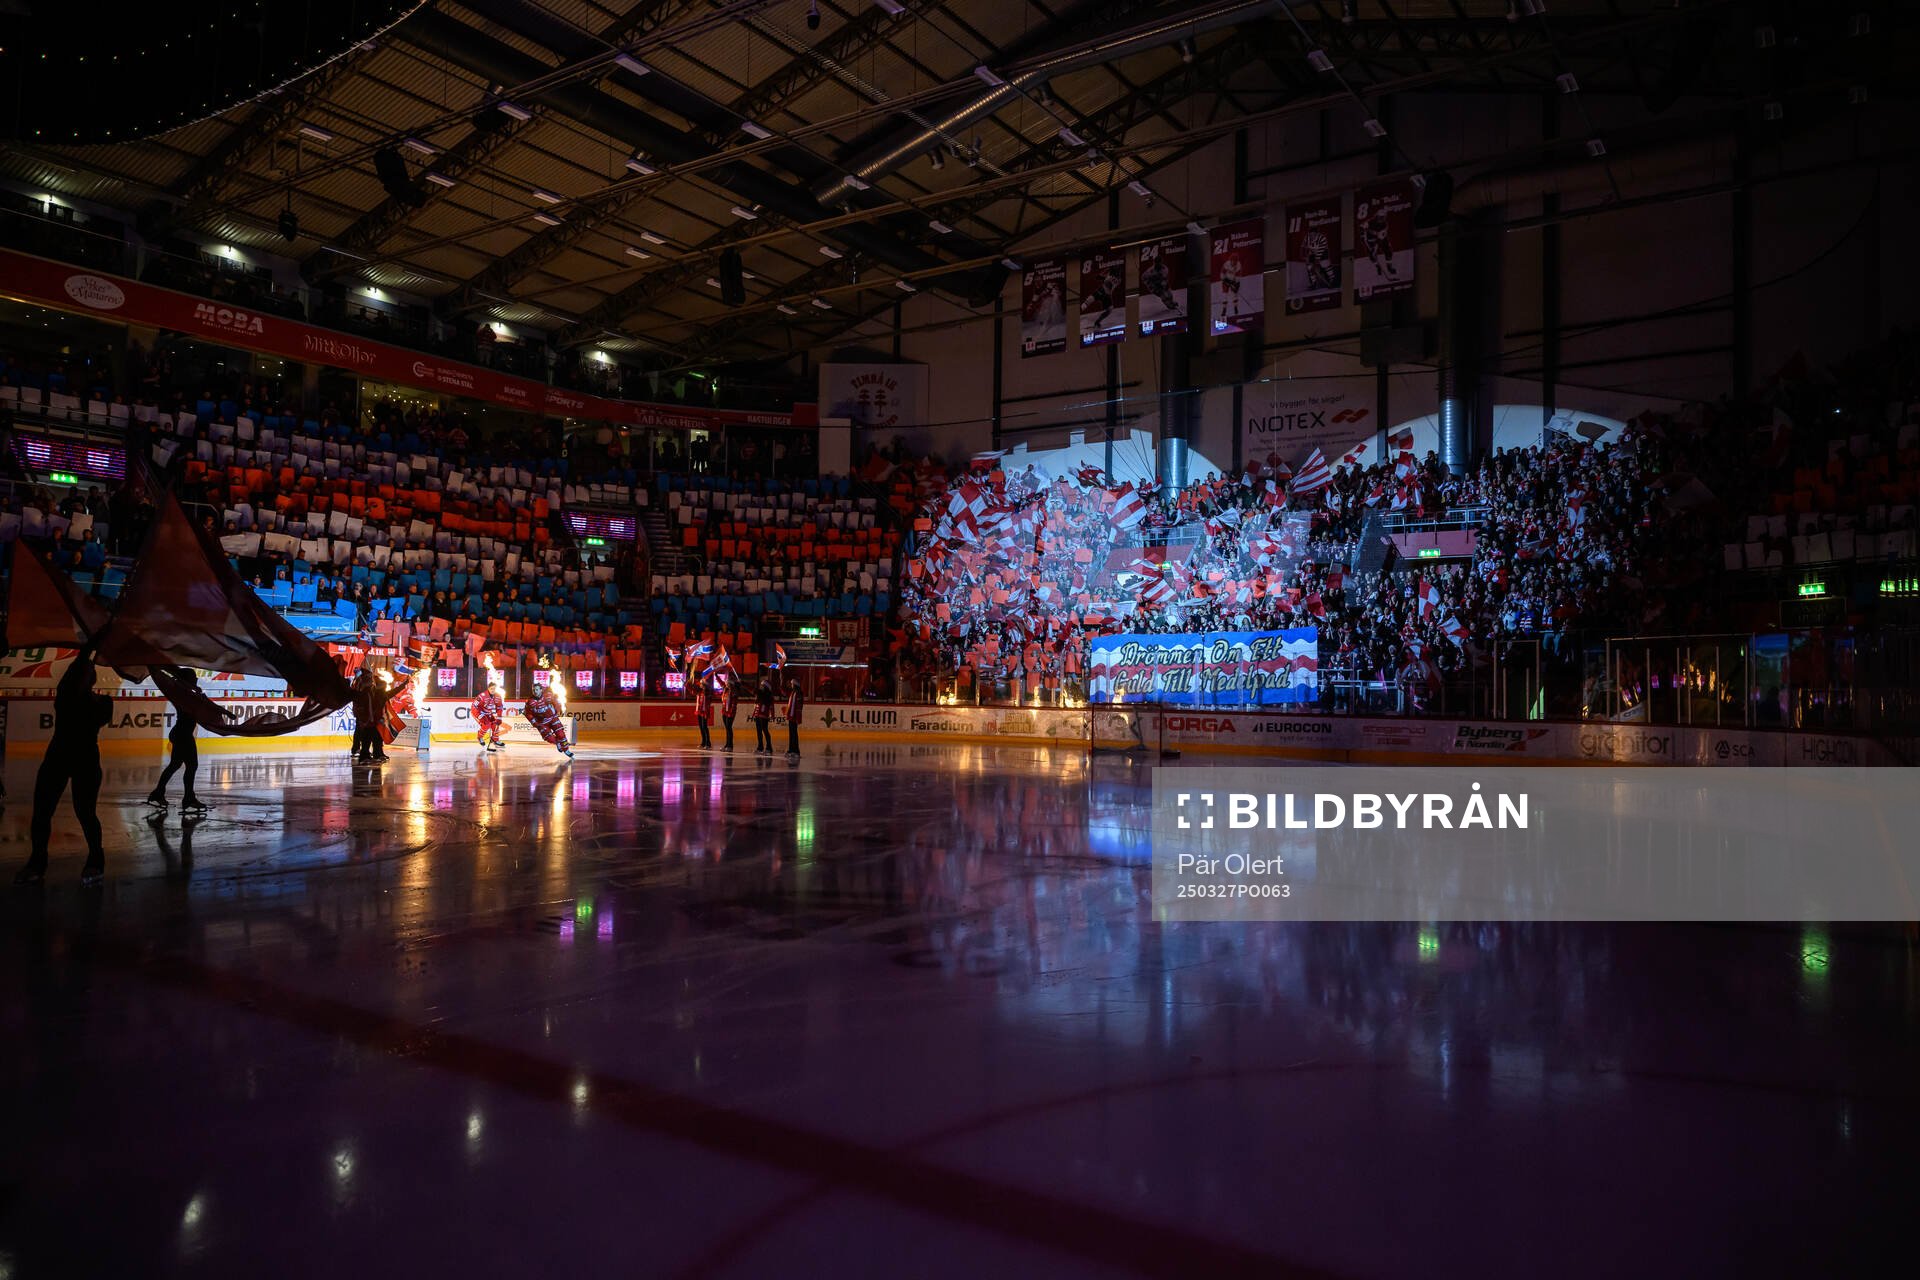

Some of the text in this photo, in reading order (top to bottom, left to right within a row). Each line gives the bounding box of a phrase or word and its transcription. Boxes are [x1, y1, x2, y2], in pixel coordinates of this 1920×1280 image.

[1357, 203, 1369, 220] 8
[1288, 217, 1302, 233] 11
[1140, 245, 1159, 262] 24
[1213, 238, 1229, 256] 21
[1082, 259, 1092, 274] 8
[1024, 272, 1034, 287] 5
[193, 303, 265, 334] MOBA
[1249, 410, 1325, 434] NOTEX
[1120, 635, 1282, 667] Drömmen Om Ett
[1114, 663, 1291, 700] Guld Till Medelpad
[840, 709, 897, 724] LILIUM
[911, 719, 974, 731] Faradium
[1267, 722, 1332, 734] EUROCON
[1458, 726, 1523, 741] Byberg
[1455, 740, 1506, 749] & Nordin
[1580, 731, 1669, 756] granitor
[1732, 743, 1755, 757] SCA
